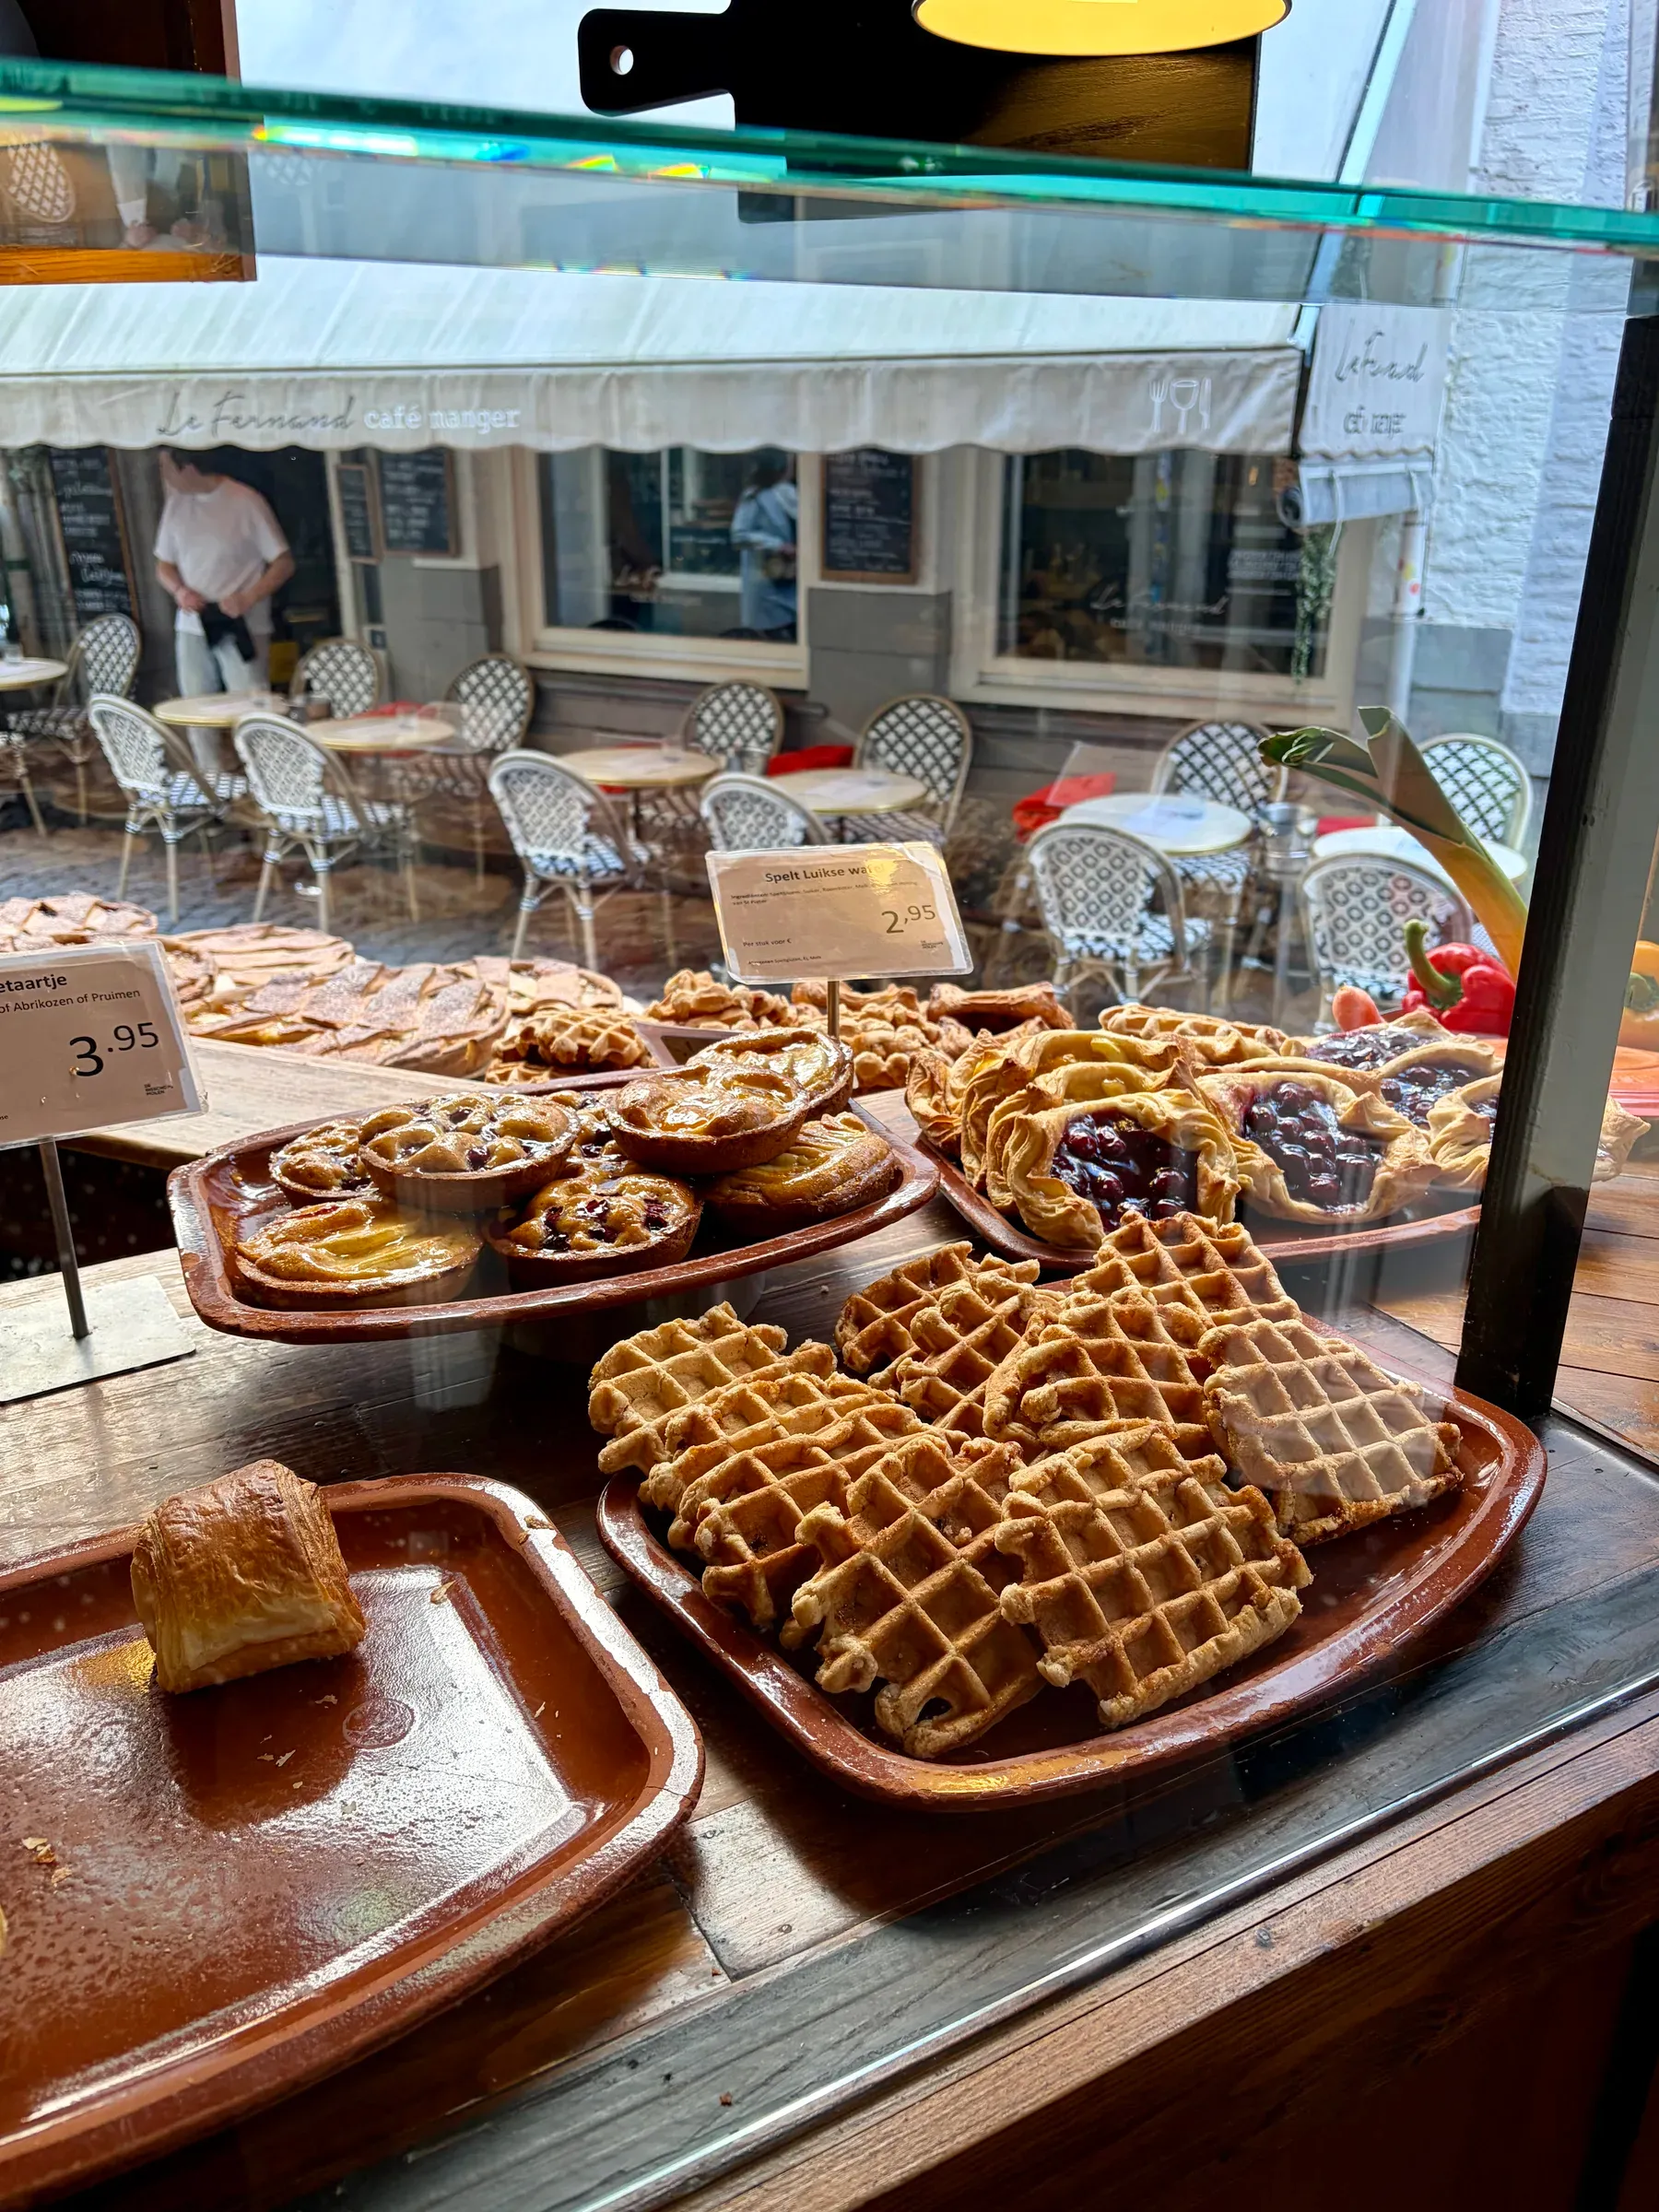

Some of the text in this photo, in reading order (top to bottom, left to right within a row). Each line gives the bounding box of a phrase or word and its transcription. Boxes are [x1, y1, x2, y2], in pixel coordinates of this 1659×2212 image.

[157, 392, 203, 438] Le
[211, 389, 356, 439] Fernand
[364, 403, 423, 430] café
[765, 870, 801, 884] Spelt
[803, 867, 845, 879] Luikse
[881, 904, 936, 935] 2,95
[14, 996, 74, 1012] Abrikozen
[76, 993, 88, 1004] of
[91, 989, 141, 1003] Pruimen
[68, 1021, 159, 1077] 3.95
